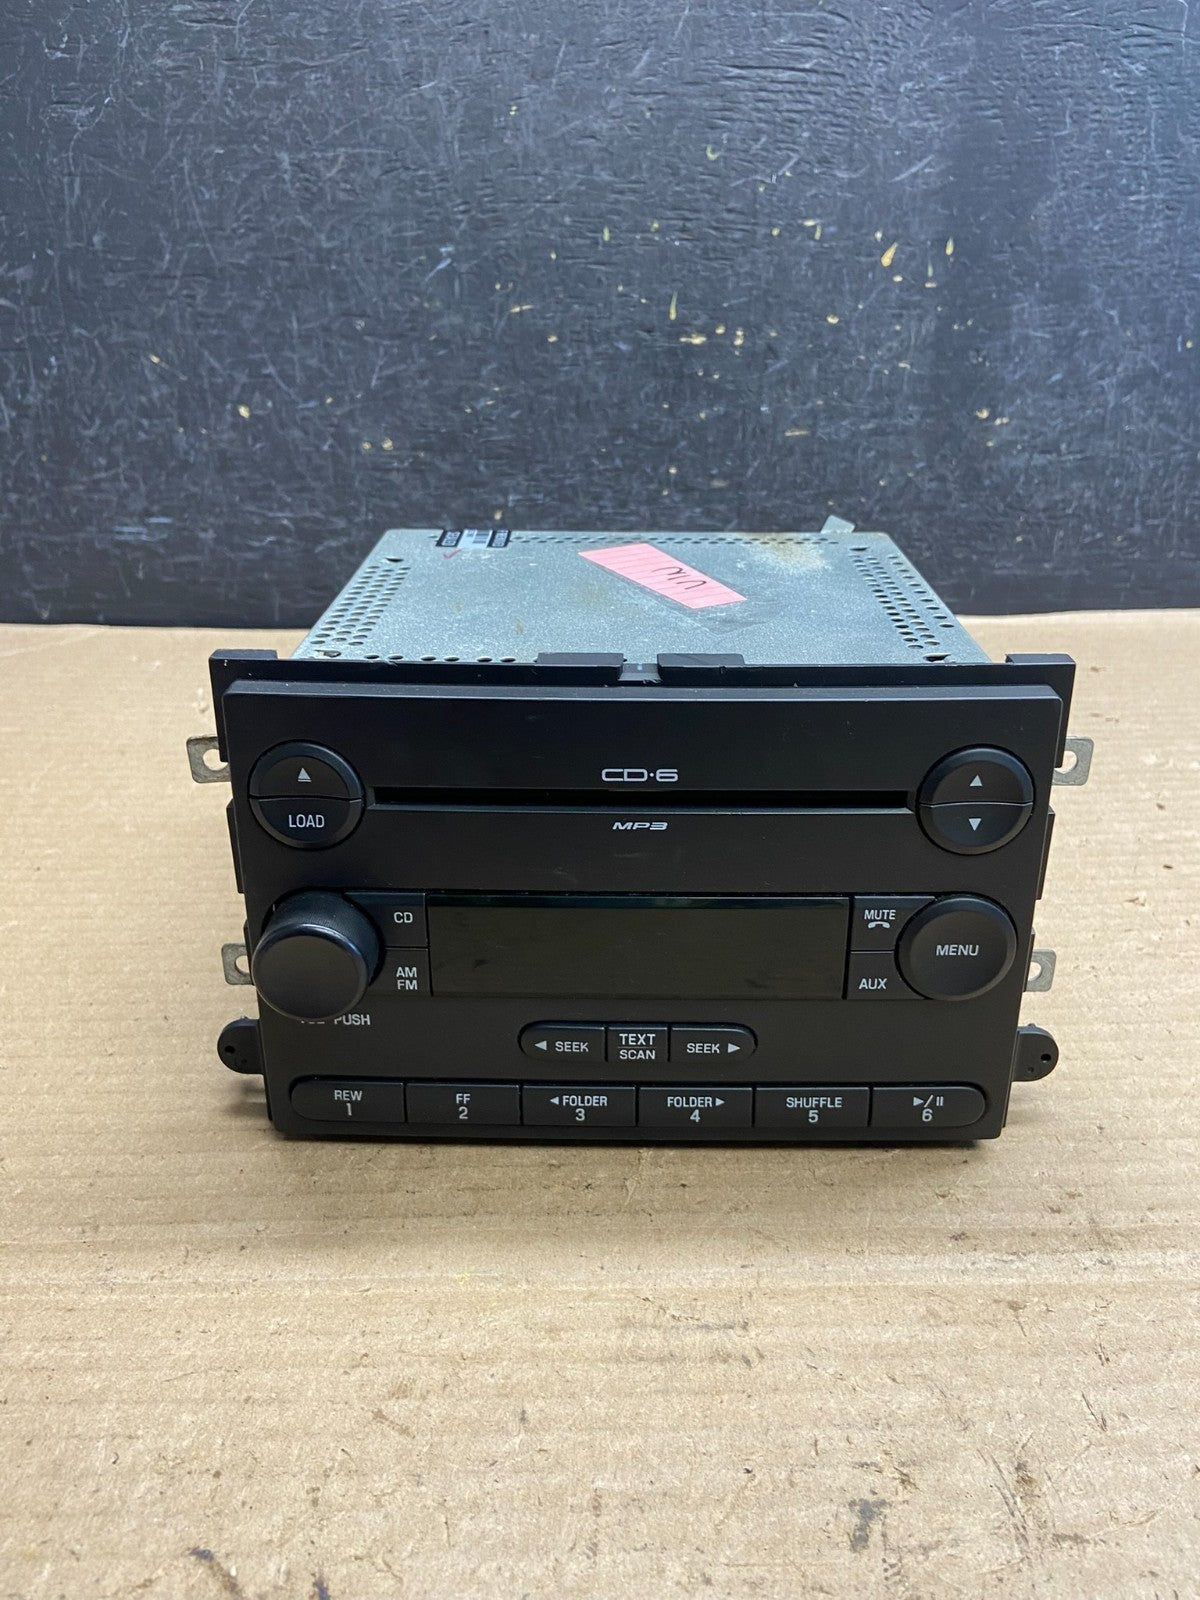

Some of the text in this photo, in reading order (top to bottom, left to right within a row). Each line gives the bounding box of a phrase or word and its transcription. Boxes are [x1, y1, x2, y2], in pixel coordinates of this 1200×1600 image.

[288, 813, 325, 828] LOAD
[612, 821, 669, 831] MP3
[393, 911, 413, 924] CD
[864, 909, 897, 920] MUTE
[936, 944, 979, 956] MENU
[396, 966, 418, 978] AM
[397, 979, 418, 990] FM
[858, 978, 888, 990] AUX
[619, 1033, 656, 1045] TEXT
[555, 1041, 589, 1053] SEEK
[686, 1042, 720, 1054] SEEK
[619, 1049, 656, 1060] SCAN
[334, 1089, 363, 1101] REW
[455, 1093, 471, 1104] FF
[562, 1095, 608, 1107] FOLDER
[667, 1096, 713, 1108] FOLDER
[786, 1096, 843, 1108] SHUFFLE
[346, 1102, 352, 1116] 1
[458, 1106, 469, 1120] 2
[575, 1108, 586, 1121] 3
[922, 1108, 933, 1122] 6
[689, 1109, 701, 1123] 4
[808, 1109, 819, 1123] 5
